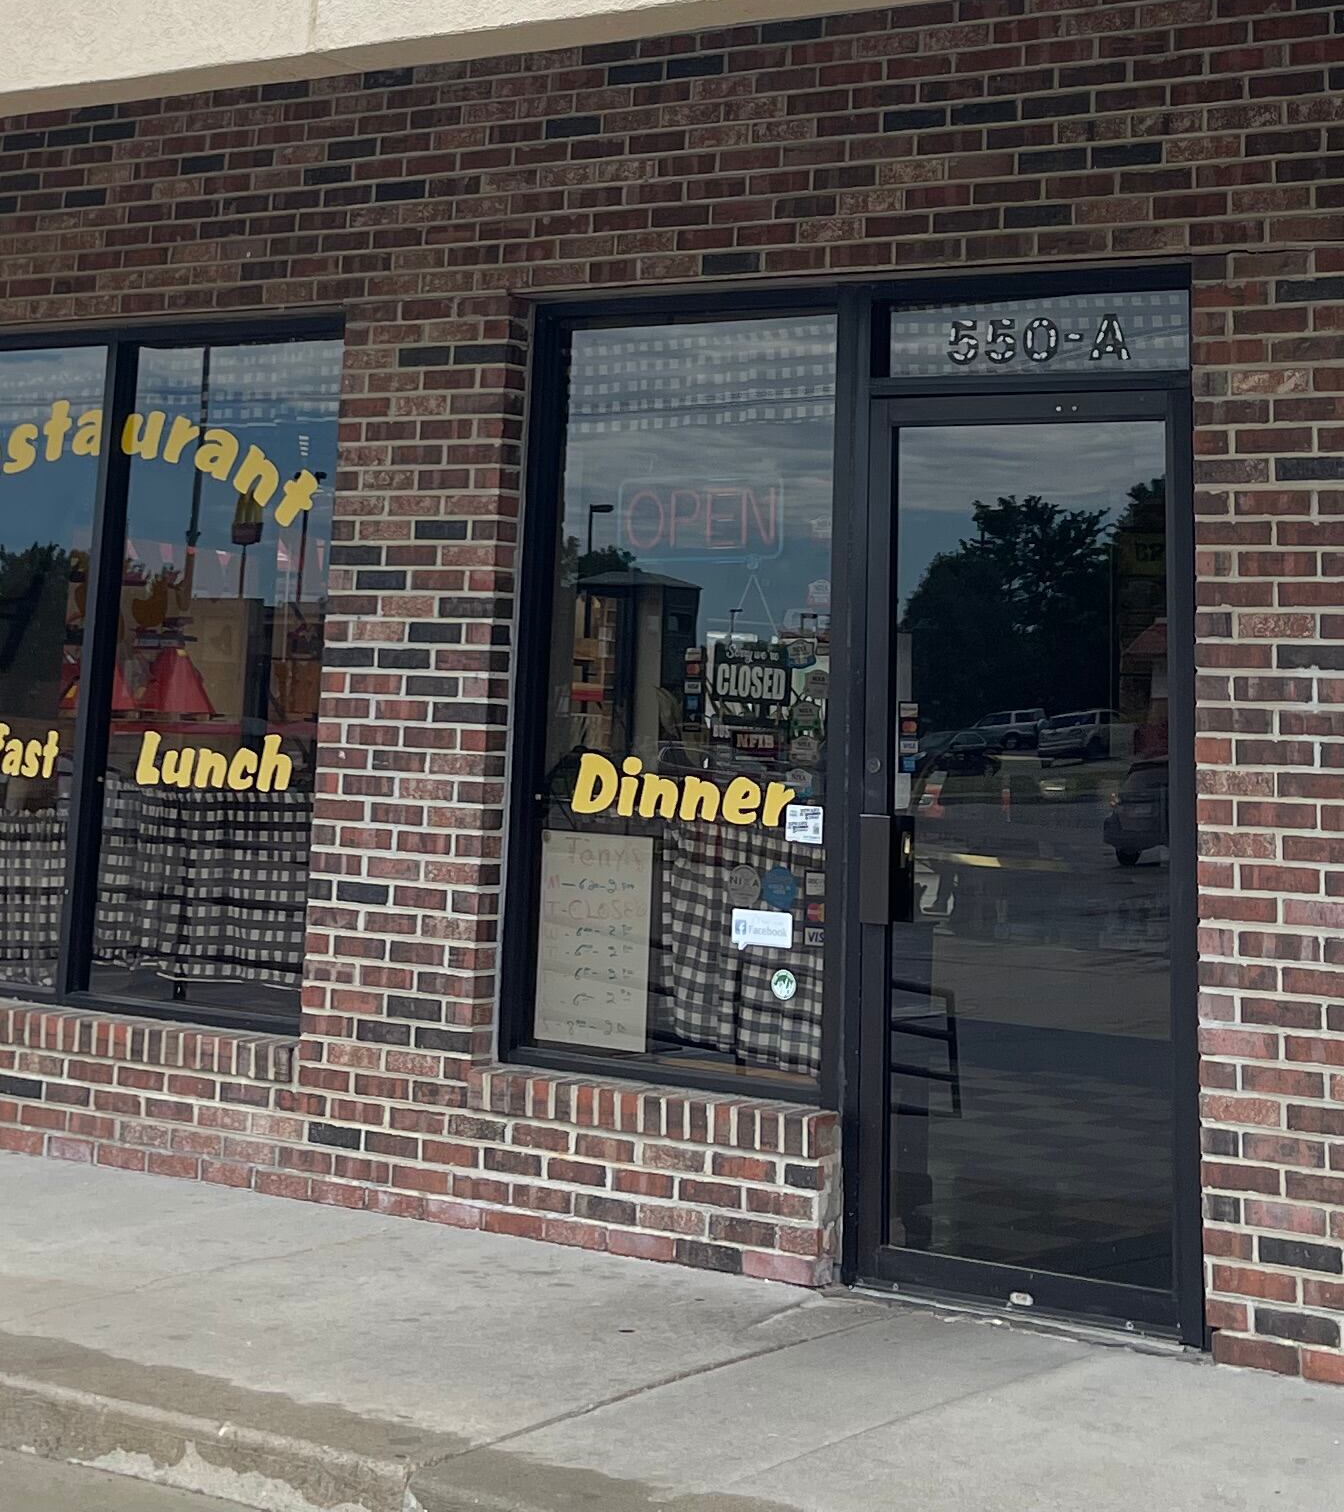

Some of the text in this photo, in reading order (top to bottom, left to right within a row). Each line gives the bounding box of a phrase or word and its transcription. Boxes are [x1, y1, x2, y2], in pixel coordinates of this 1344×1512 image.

[947, 313, 1132, 366] 550-A
[626, 487, 776, 550] OPEN
[716, 663, 786, 700] CLOSED
[135, 731, 293, 792] Lunch
[571, 753, 796, 827] Dinner
[808, 930, 825, 943] VIS
